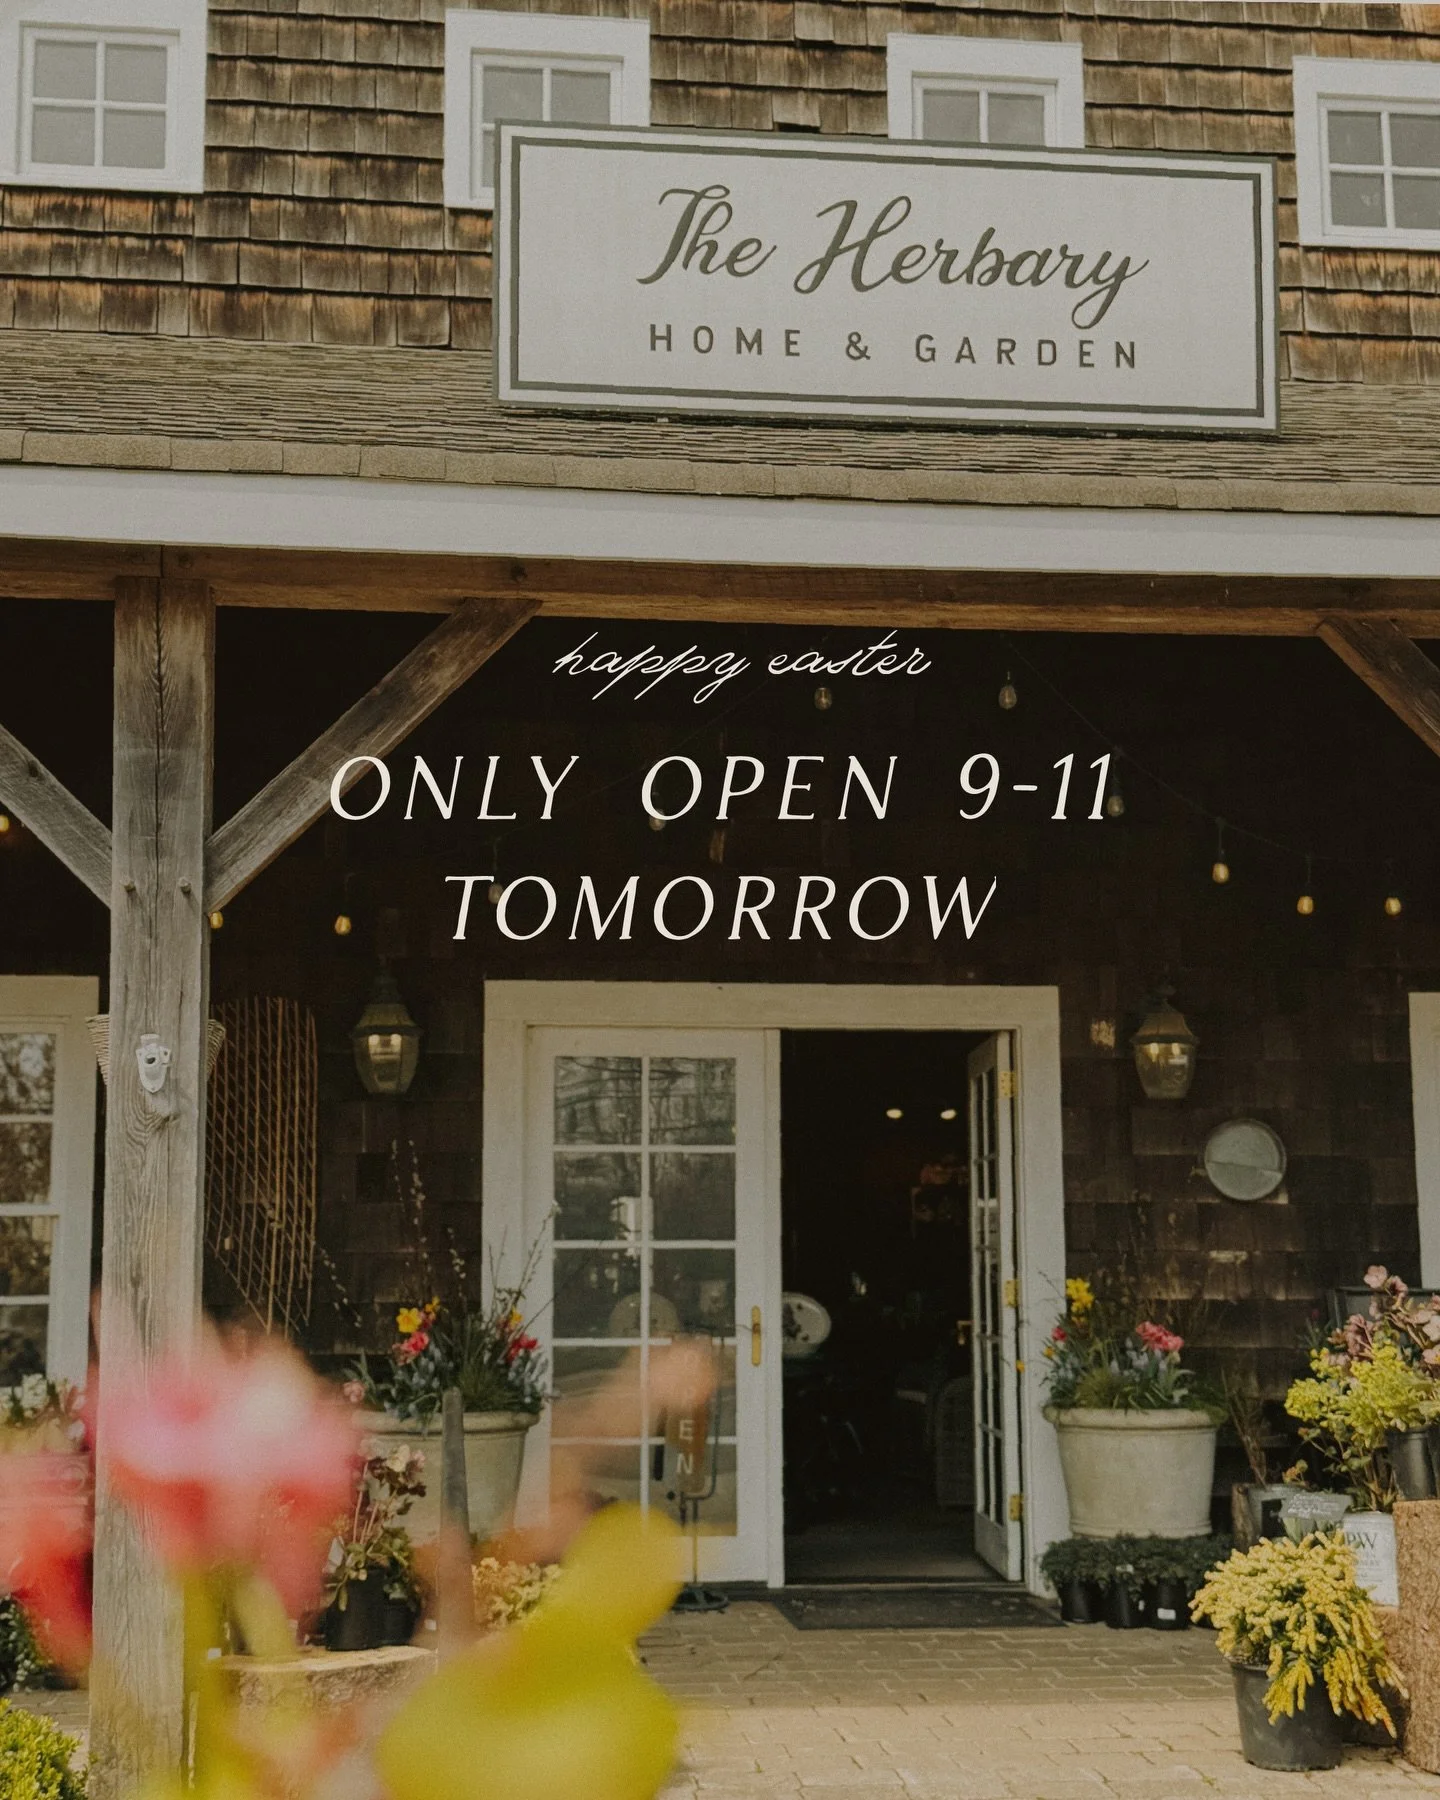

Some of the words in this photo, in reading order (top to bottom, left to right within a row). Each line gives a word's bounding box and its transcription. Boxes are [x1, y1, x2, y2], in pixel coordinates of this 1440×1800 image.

[636, 184, 778, 285] The
[792, 195, 1150, 330] Herbary
[650, 323, 801, 357] HOME
[845, 331, 872, 361] &
[915, 333, 1136, 369] GARDEN
